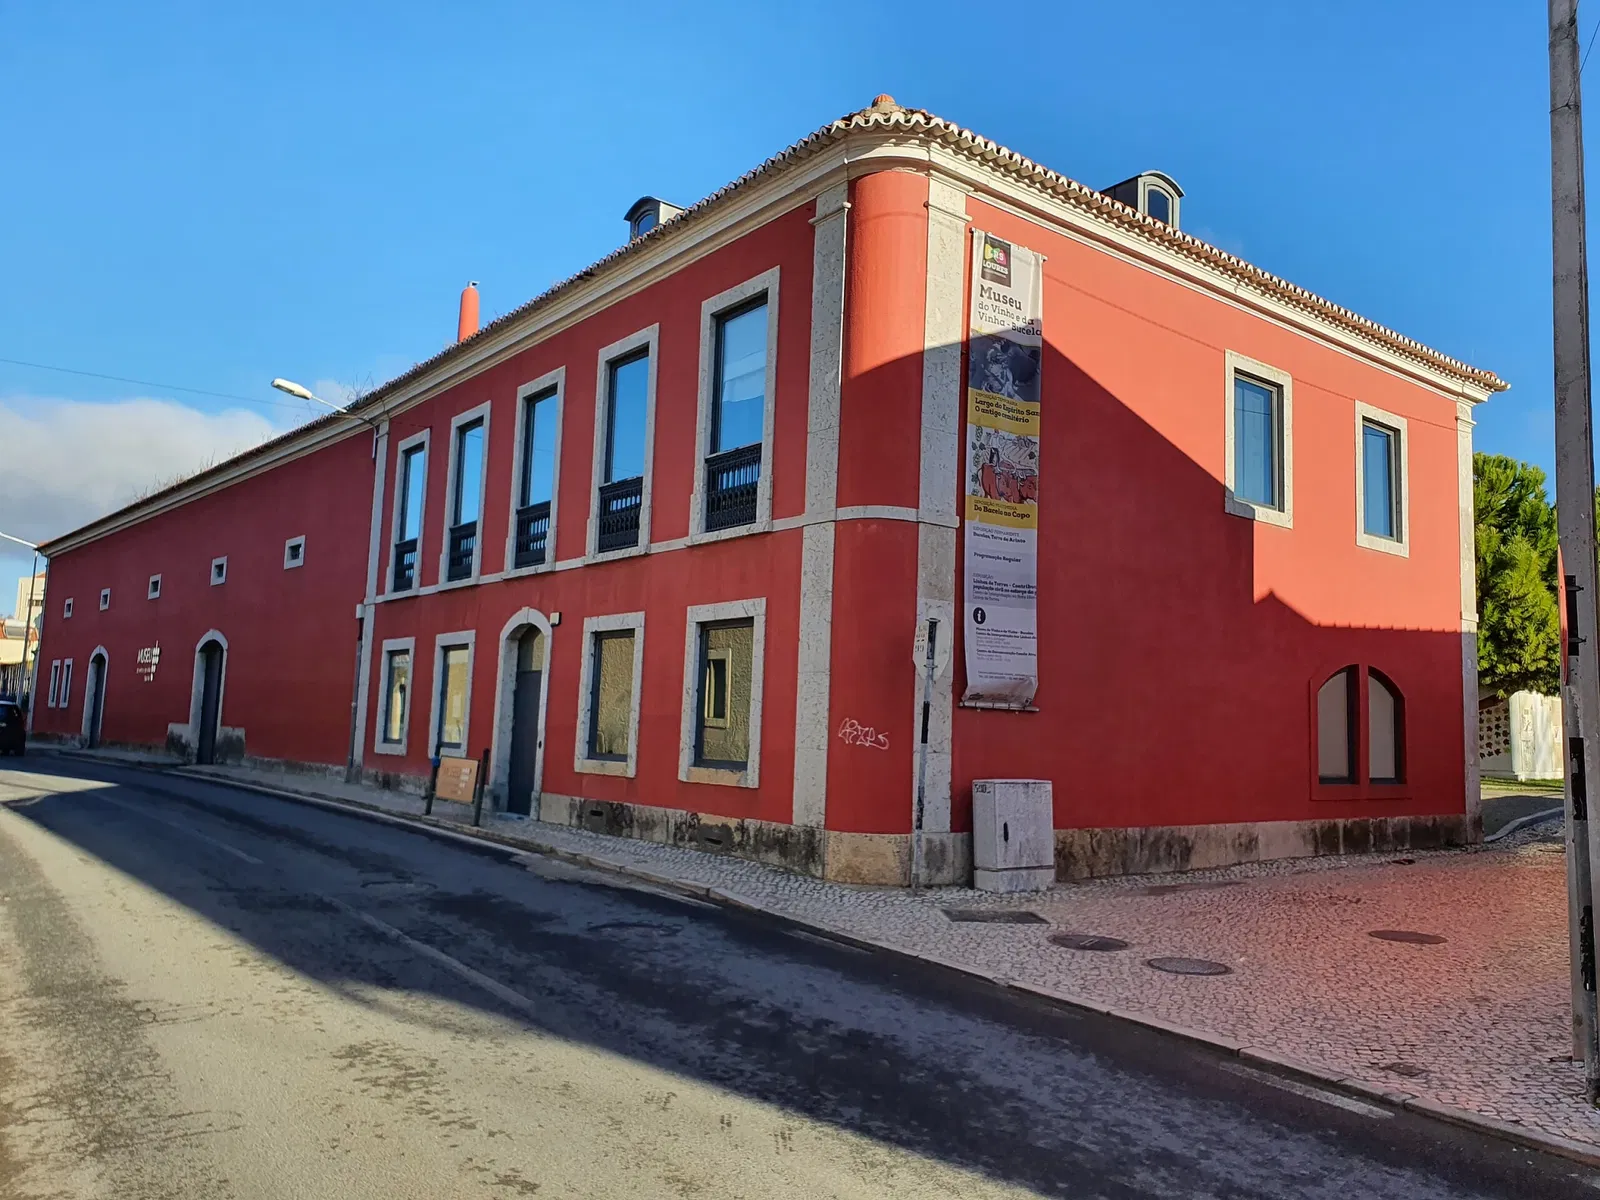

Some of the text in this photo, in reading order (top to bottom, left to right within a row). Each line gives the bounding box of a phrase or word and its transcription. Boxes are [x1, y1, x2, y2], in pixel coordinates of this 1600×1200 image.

[982, 260, 1009, 275] LOURES
[979, 284, 1022, 311] Museu
[978, 301, 989, 311] do
[991, 303, 1015, 319] Vinho
[1022, 316, 1035, 326] da
[978, 311, 1006, 327] Vinha
[974, 397, 994, 408] Largo
[981, 408, 1002, 418] antigo
[974, 504, 983, 512] Do
[983, 506, 1003, 515] Bacelo
[1012, 511, 1031, 520] Copo
